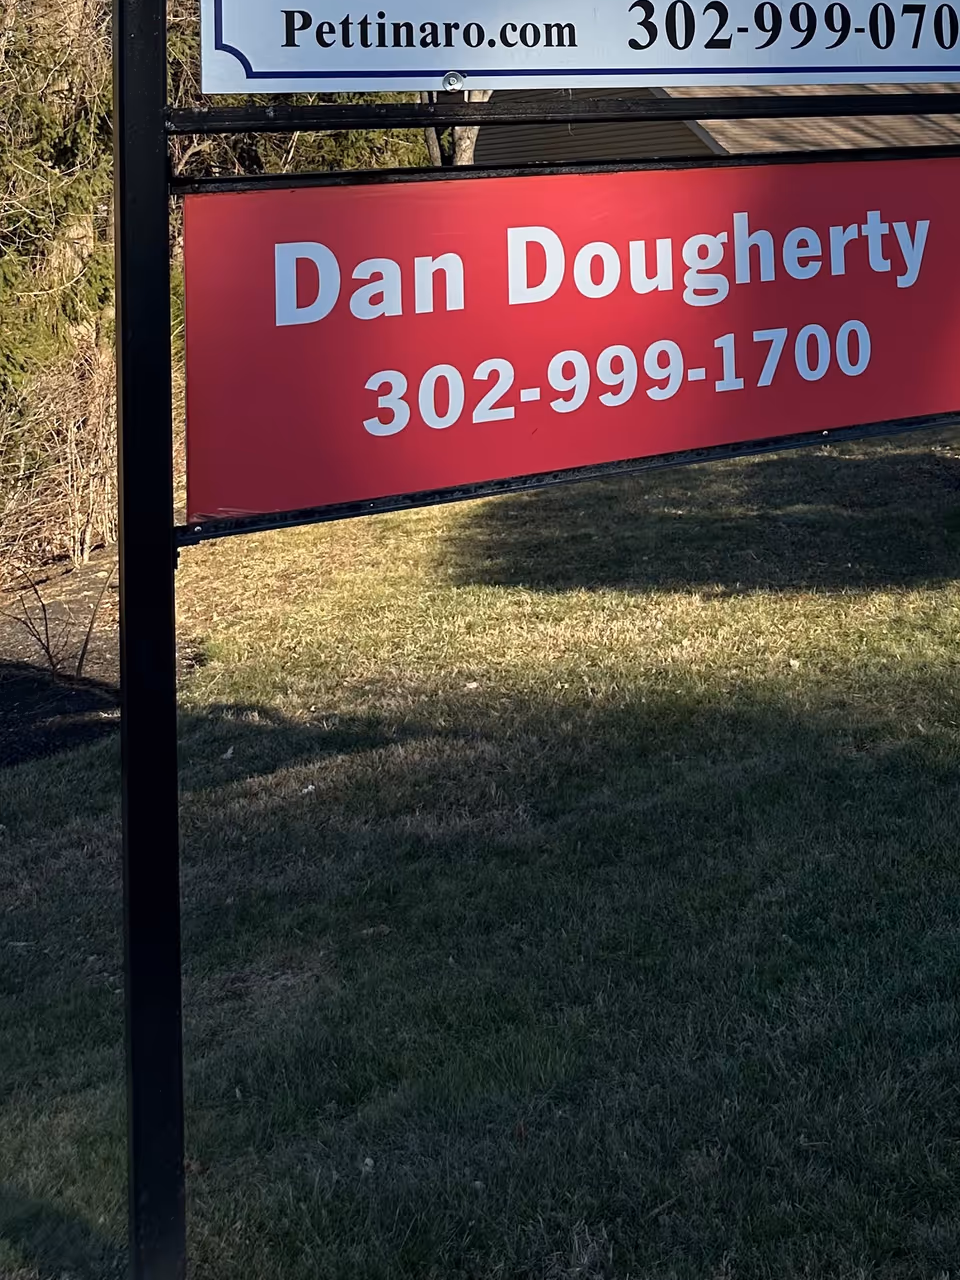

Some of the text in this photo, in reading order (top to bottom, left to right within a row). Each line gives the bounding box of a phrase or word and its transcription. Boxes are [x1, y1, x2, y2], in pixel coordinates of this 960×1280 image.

[281, 9, 578, 49] Pettinaro.com
[274, 210, 930, 327] Dan Dougherty
[362, 319, 872, 436] 302-999-1700
